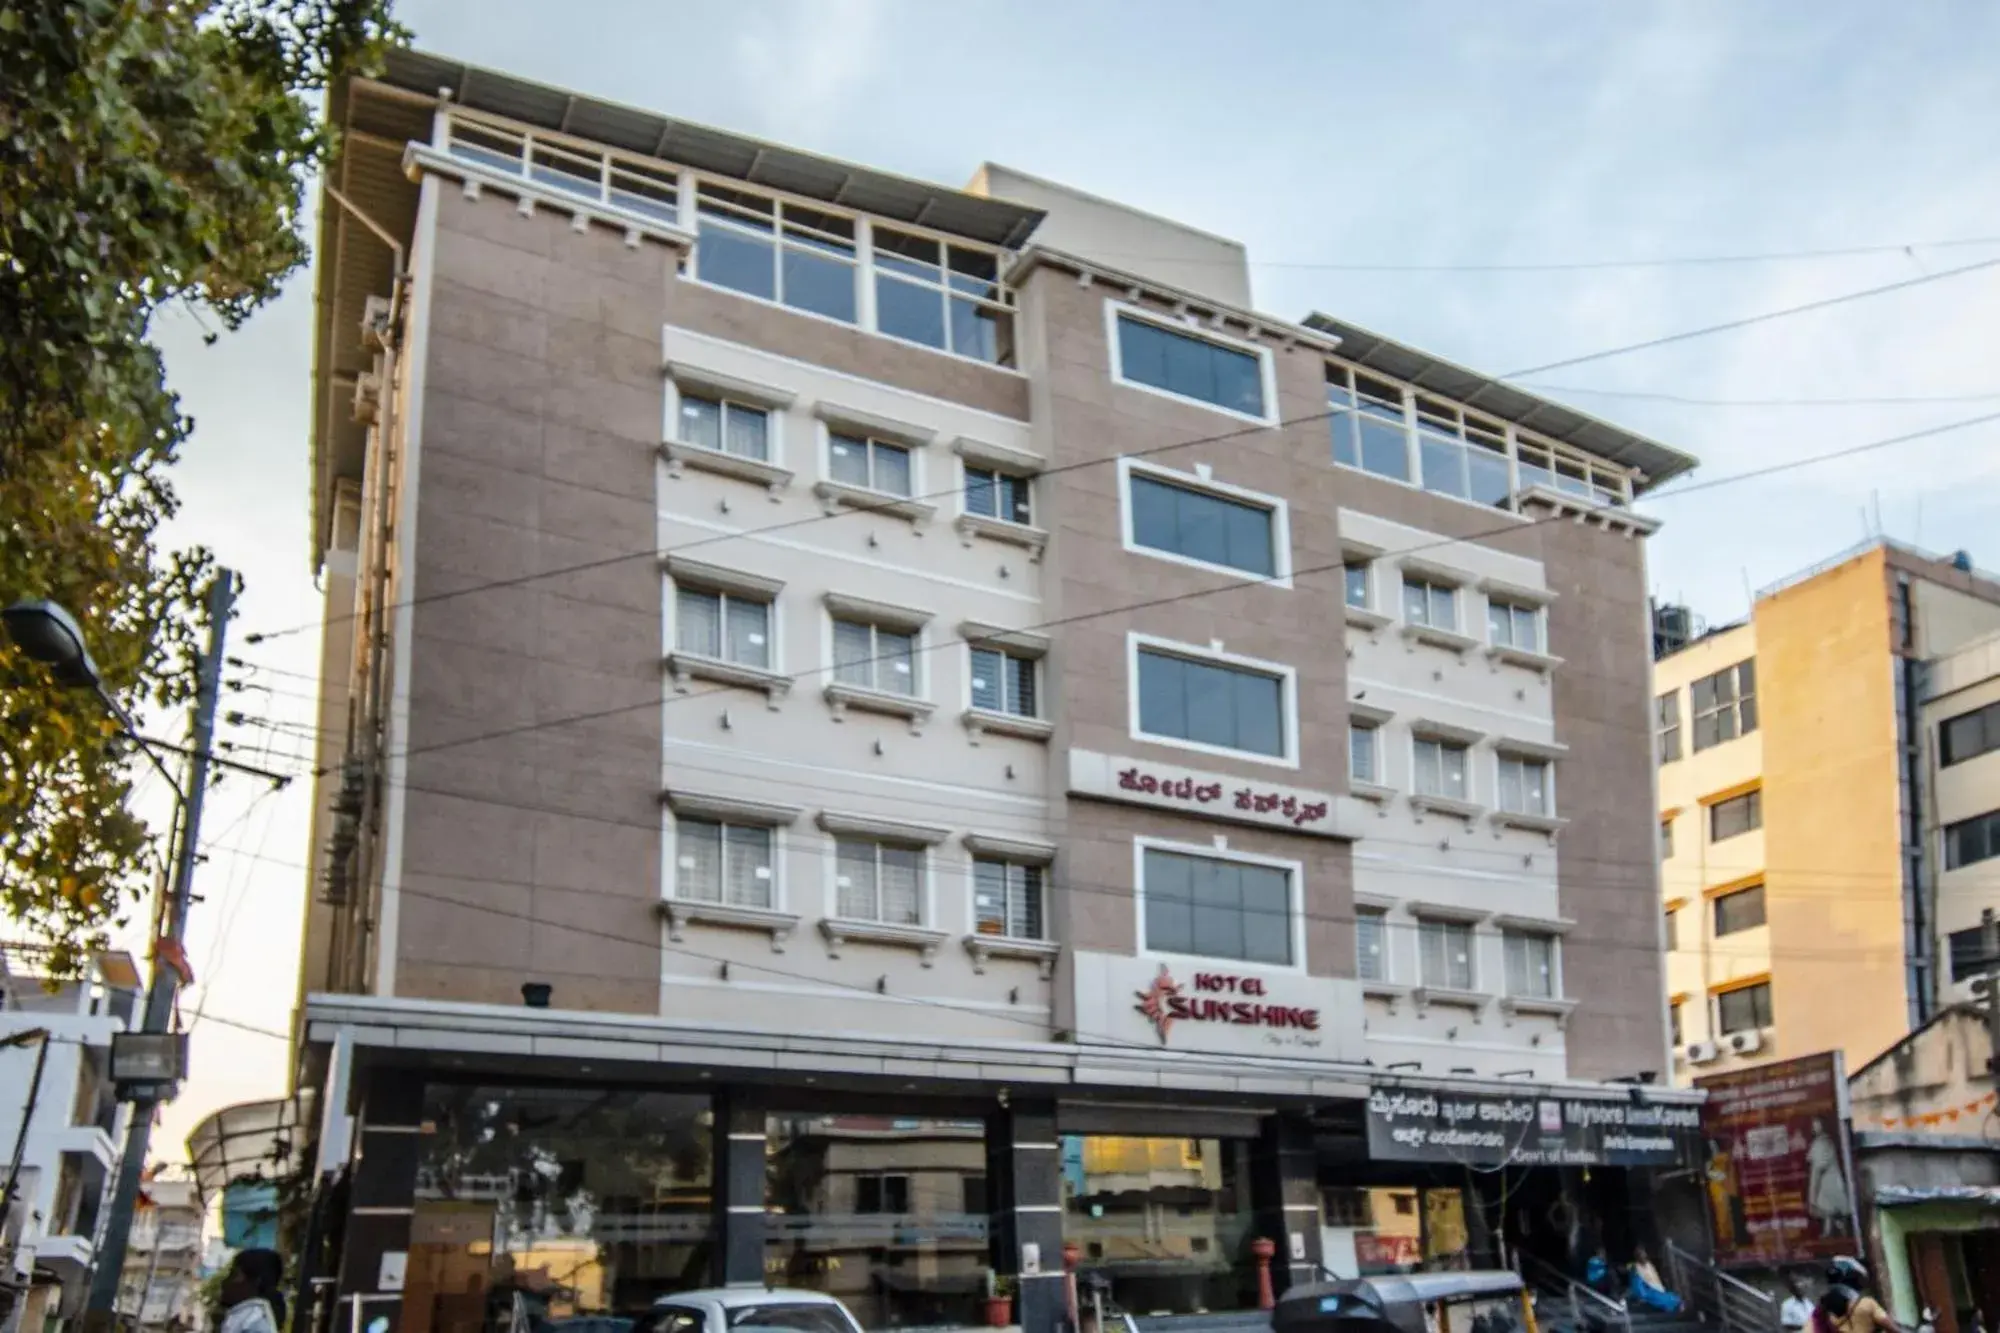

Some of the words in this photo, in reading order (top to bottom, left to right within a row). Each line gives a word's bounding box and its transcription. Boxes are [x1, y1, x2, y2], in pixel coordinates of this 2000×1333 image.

[1195, 973, 1267, 996] HOTEL
[1167, 996, 1321, 1030] SUNSHINE
[1566, 1101, 1625, 1128] Mysore
